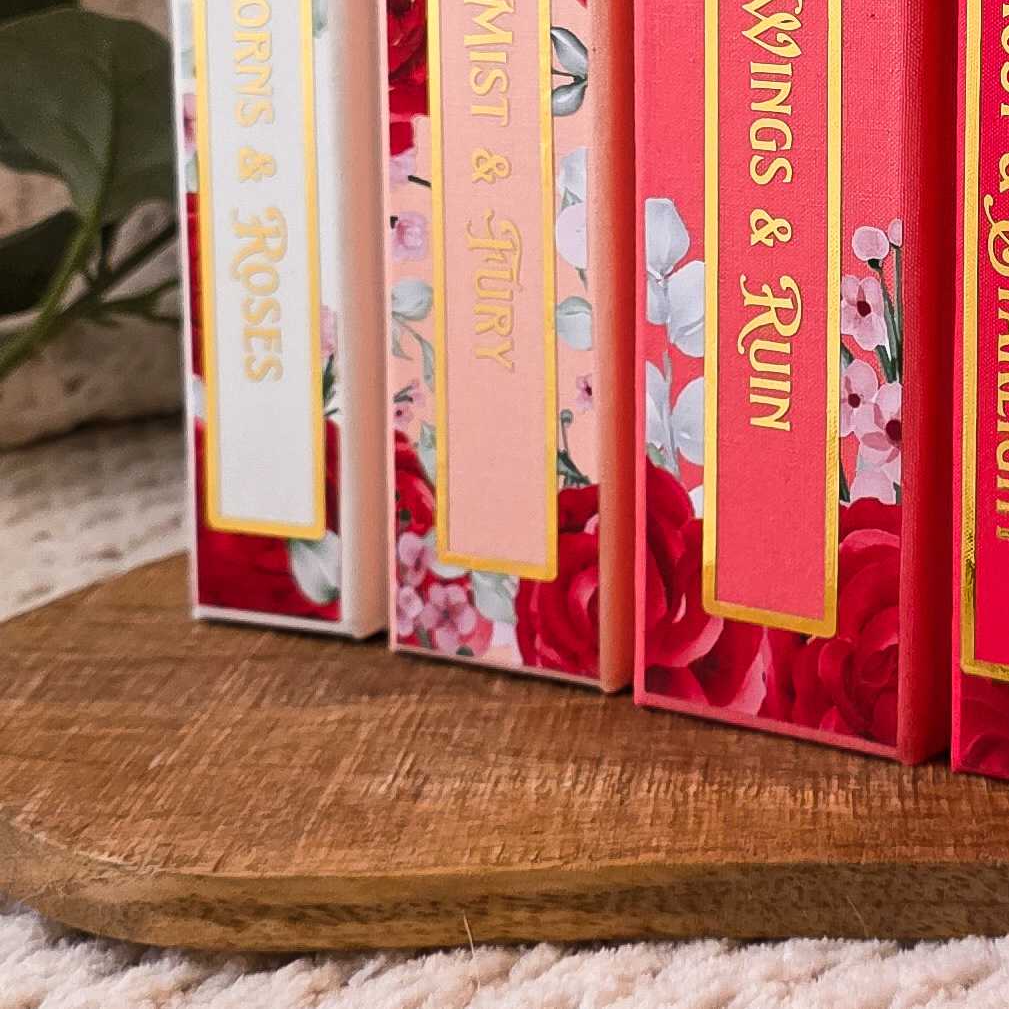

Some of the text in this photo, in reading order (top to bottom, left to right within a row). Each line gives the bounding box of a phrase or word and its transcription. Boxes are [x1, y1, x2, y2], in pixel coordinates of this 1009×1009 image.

[235, 147, 276, 183] &
[471, 147, 511, 184] &
[749, 208, 792, 247] &
[229, 205, 288, 383] ROSES
[466, 208, 522, 372] FURY
[737, 274, 801, 431] RUIN
